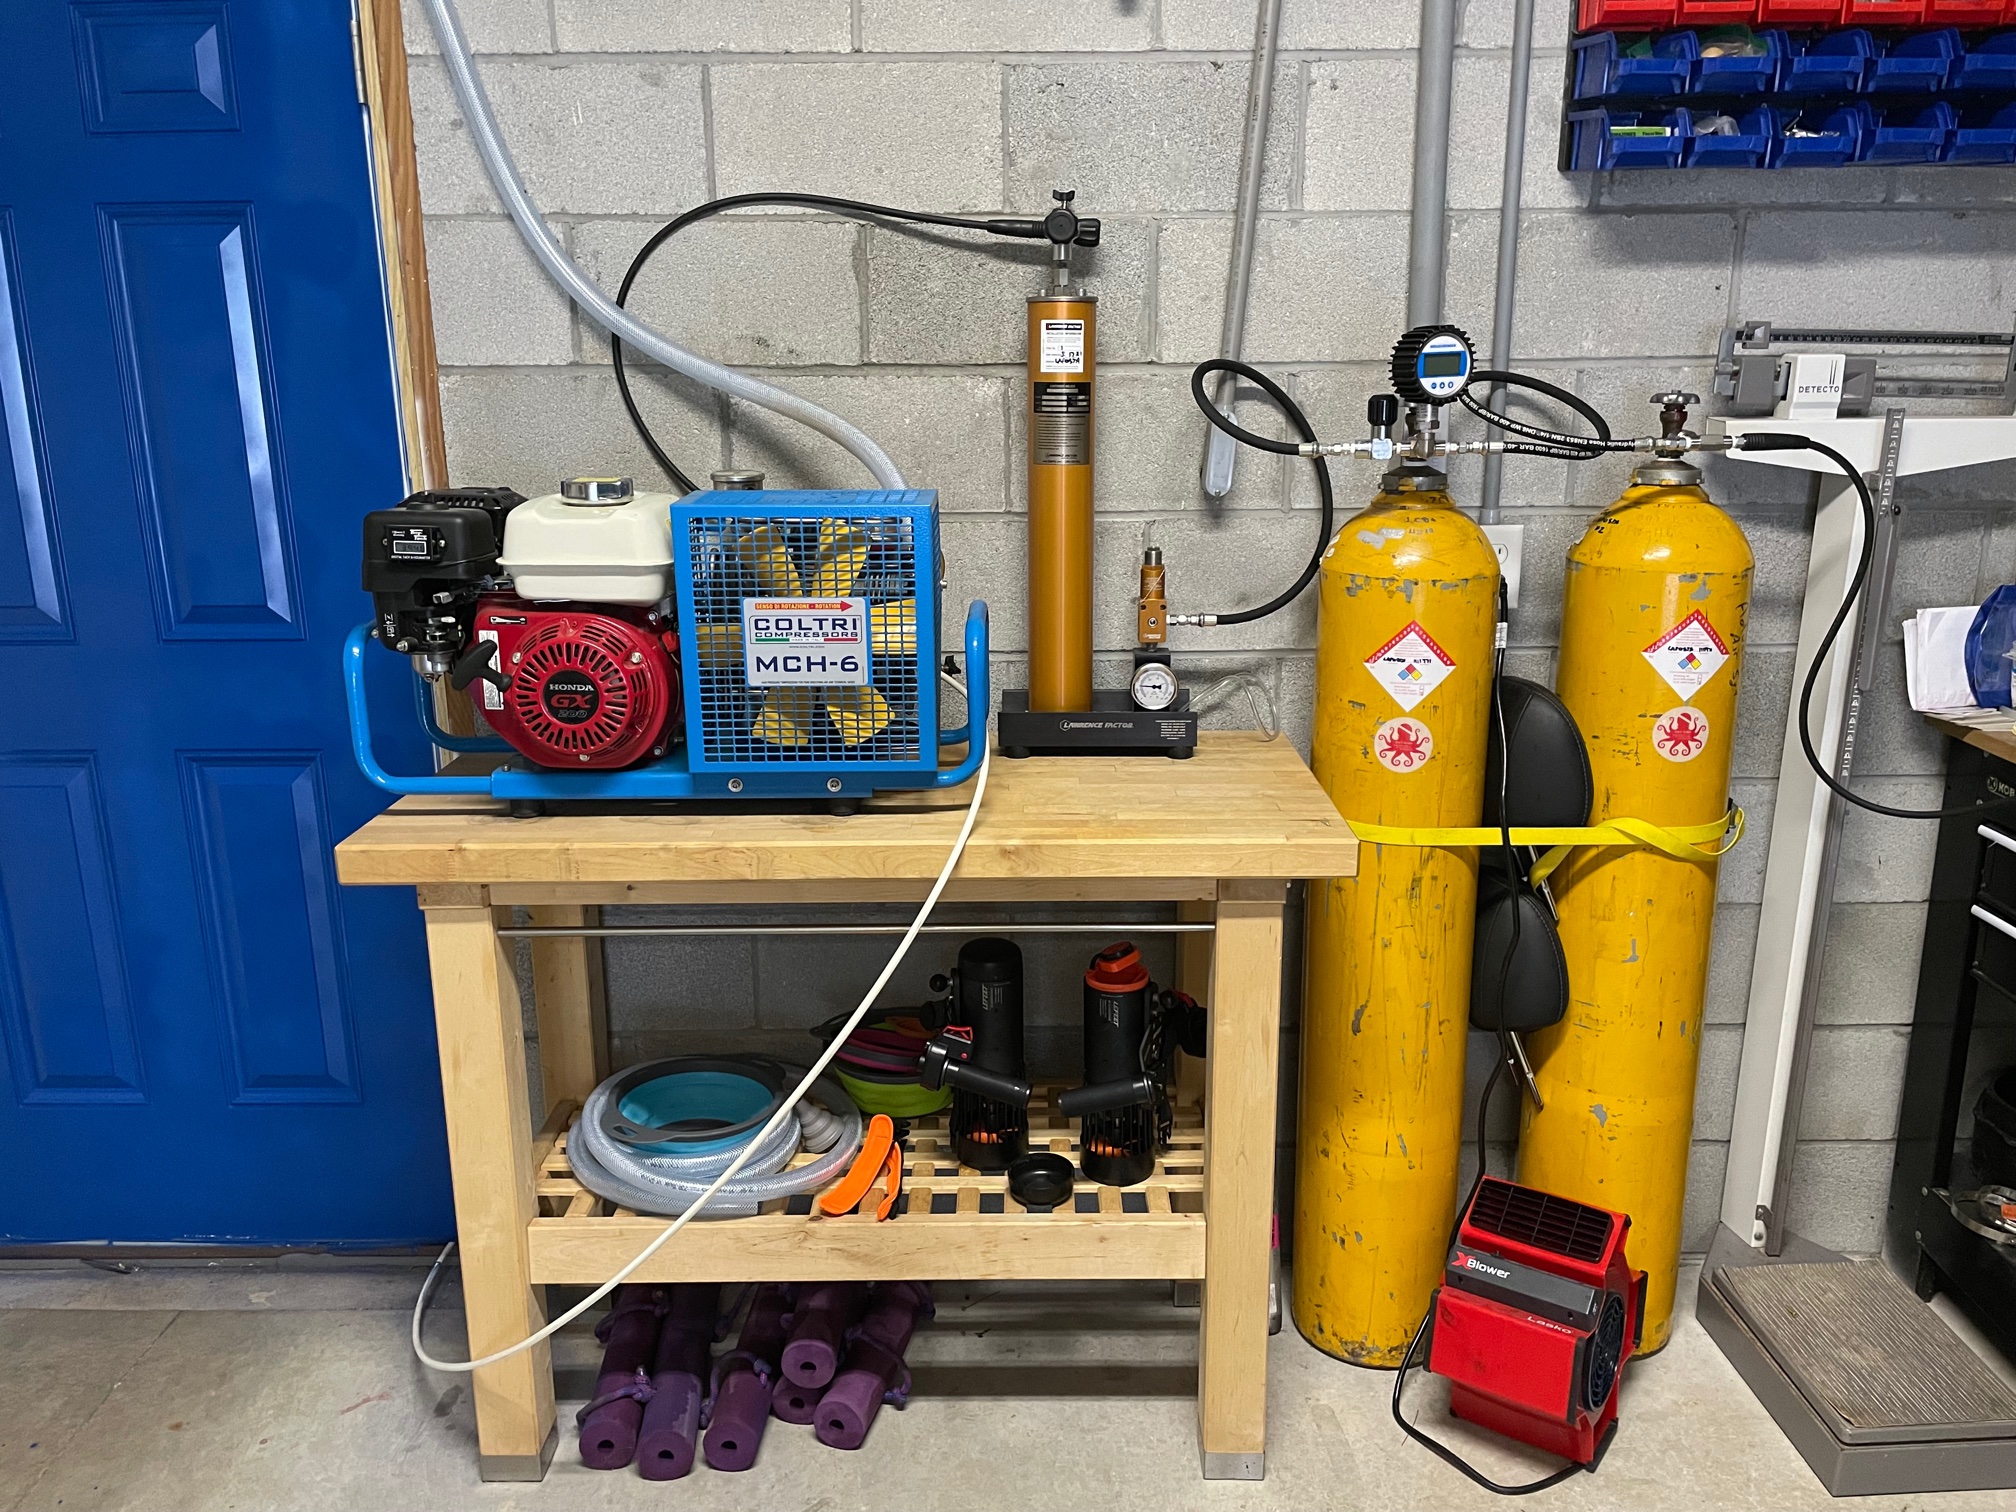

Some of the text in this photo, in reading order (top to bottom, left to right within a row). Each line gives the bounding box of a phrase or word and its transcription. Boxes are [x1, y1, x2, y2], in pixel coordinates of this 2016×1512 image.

[1798, 385, 1840, 393] DETECTO
[754, 618, 857, 631] COLTRI
[756, 656, 859, 672] MCH-6
[549, 683, 595, 691] HONDA
[551, 694, 593, 709] GX
[558, 709, 588, 718] 200
[1063, 721, 1103, 729] LAWRENCE
[1527, 1315, 1572, 1334] Lasko
